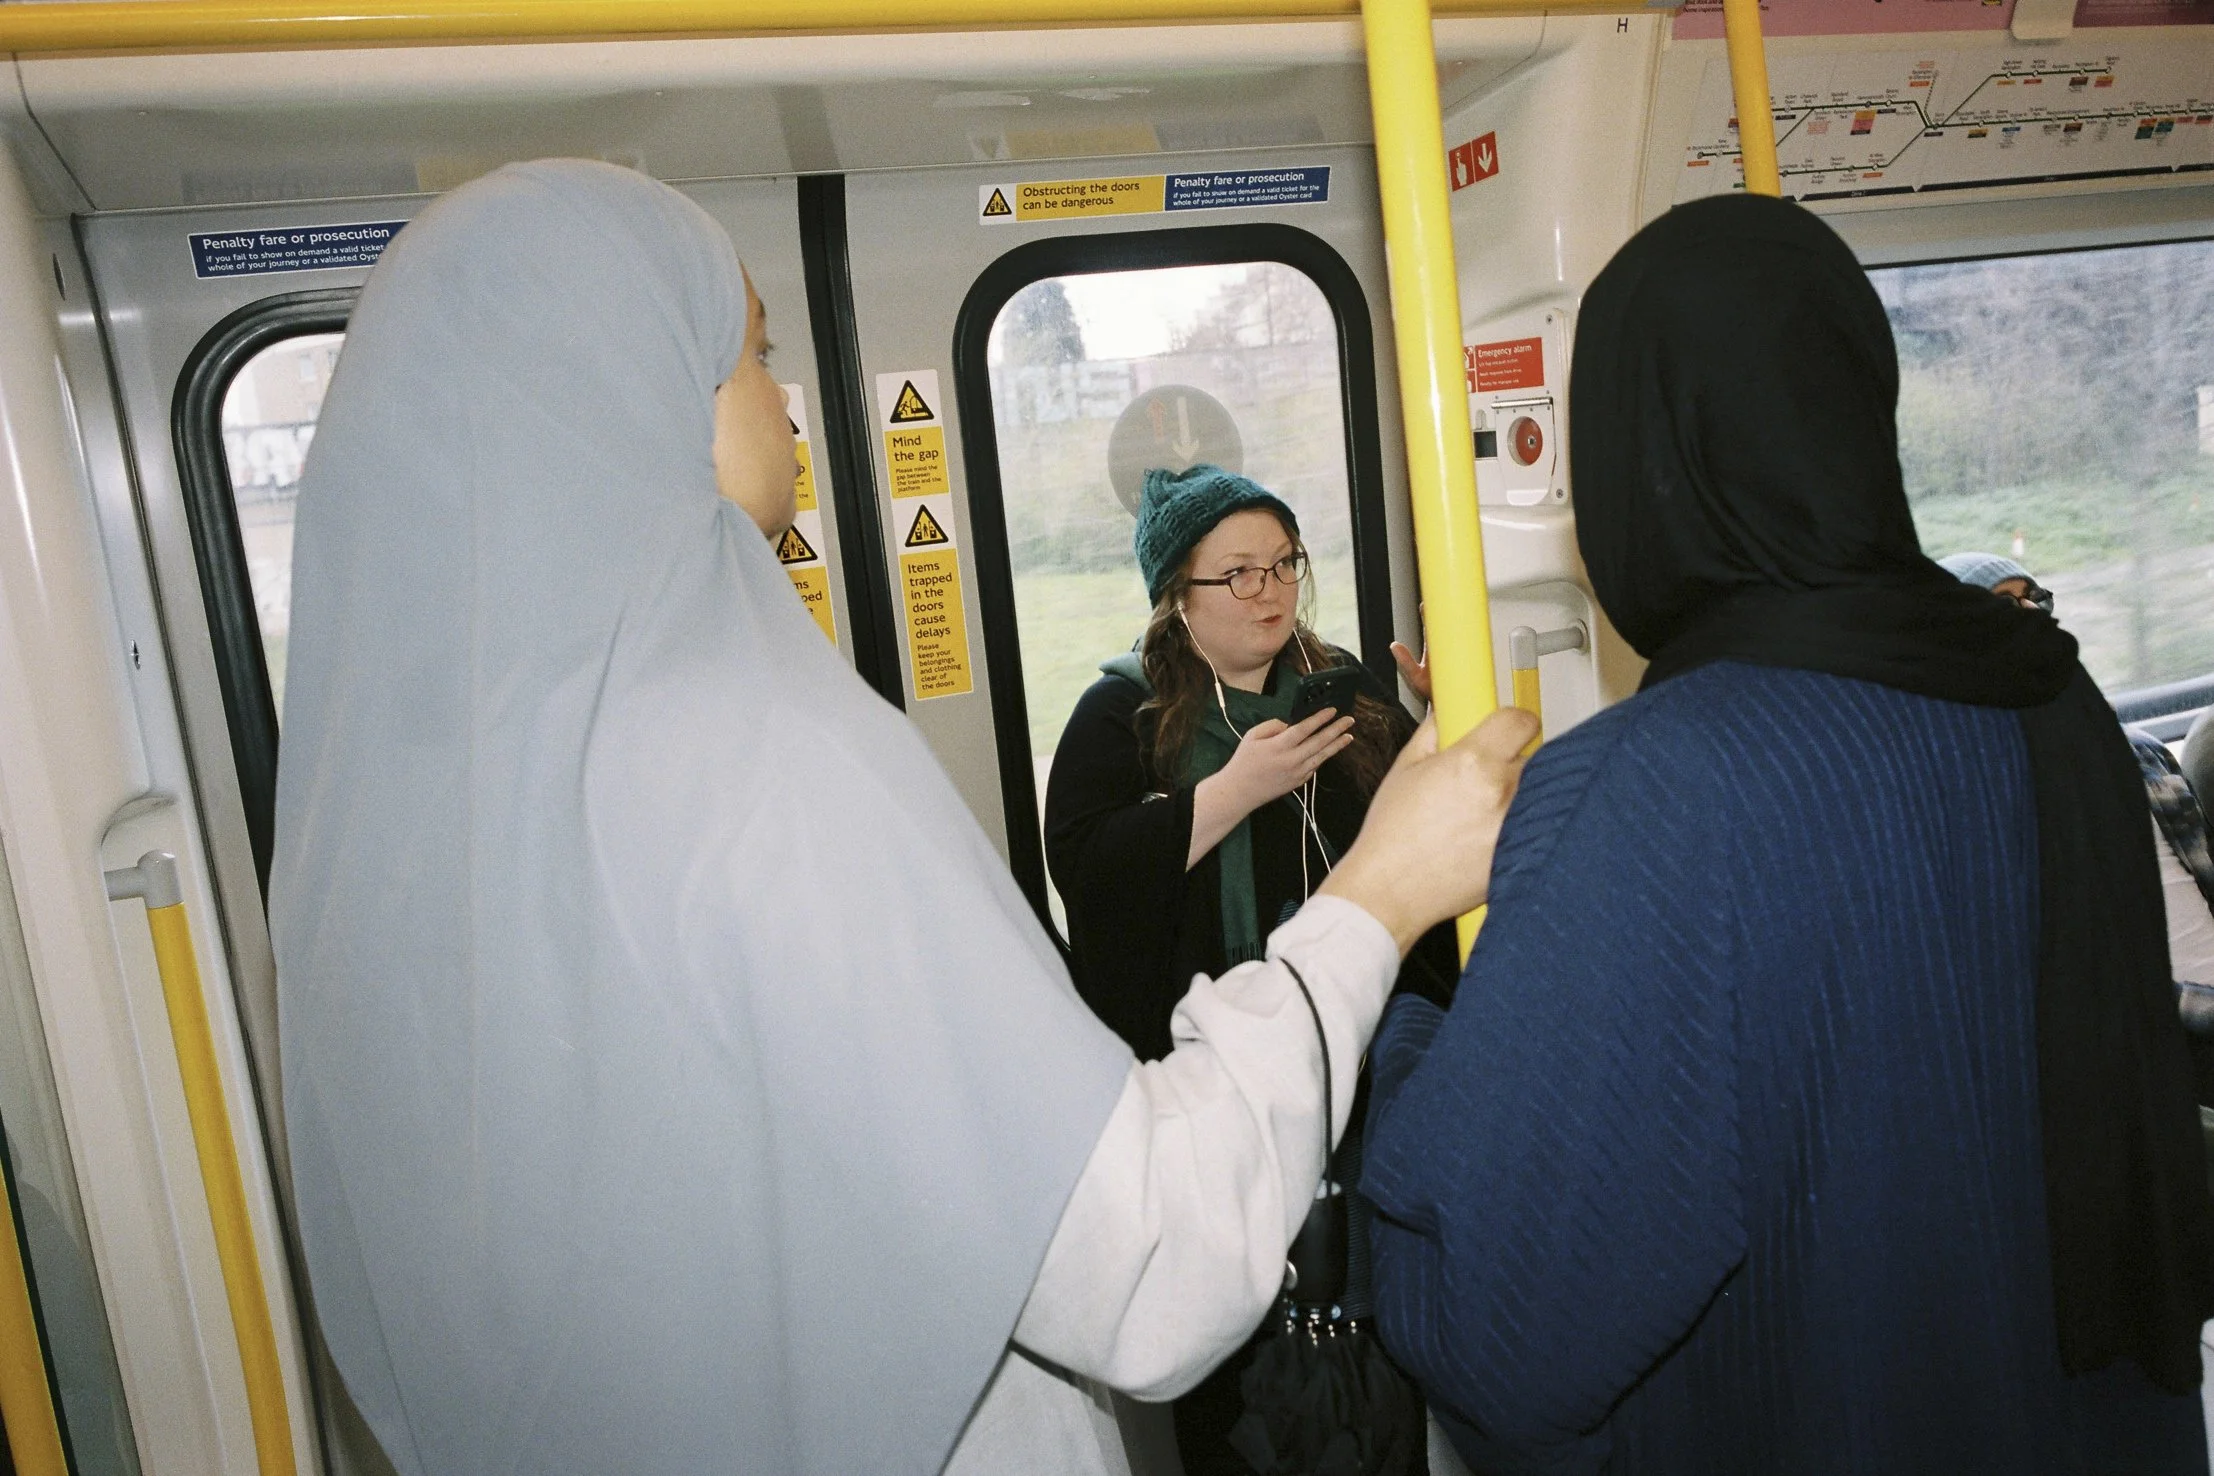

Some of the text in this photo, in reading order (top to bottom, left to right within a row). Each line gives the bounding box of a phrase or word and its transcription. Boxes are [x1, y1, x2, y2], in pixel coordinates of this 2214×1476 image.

[1617, 17, 1628, 33] H
[1174, 171, 1305, 188] Penalty fare or prosecution
[1023, 182, 1140, 197] Obstructing the doors
[1237, 188, 1261, 196] demand
[1023, 196, 1114, 210] can be dangerous
[1215, 196, 1237, 204] journey
[1251, 194, 1278, 202] validated
[202, 227, 390, 250] Penalty fare or prosecution
[205, 255, 212, 263] if
[214, 256, 231, 264] you
[232, 253, 247, 261] fail
[260, 251, 283, 259] show
[297, 247, 331, 257] demand
[339, 245, 359, 253] valid
[360, 244, 384, 252] ticket
[207, 263, 234, 272] whole
[235, 261, 245, 270] of
[247, 261, 267, 270] your
[268, 259, 300, 269] journey
[320, 254, 357, 263] validated
[1478, 345, 1532, 358] Emergency alarm
[892, 434, 922, 448] Mind
[894, 449, 939, 462] the gap
[907, 562, 940, 574] Items
[909, 572, 953, 587] trapped
[910, 588, 944, 600] in the
[912, 601, 944, 613] doors
[914, 614, 946, 626] cause
[915, 626, 951, 639] delays
[917, 643, 939, 651] Please
[936, 649, 951, 657] your
[919, 657, 956, 667] belongings
[920, 663, 962, 675] and clothing
[921, 672, 947, 683] clear of
[935, 680, 955, 688] doors
